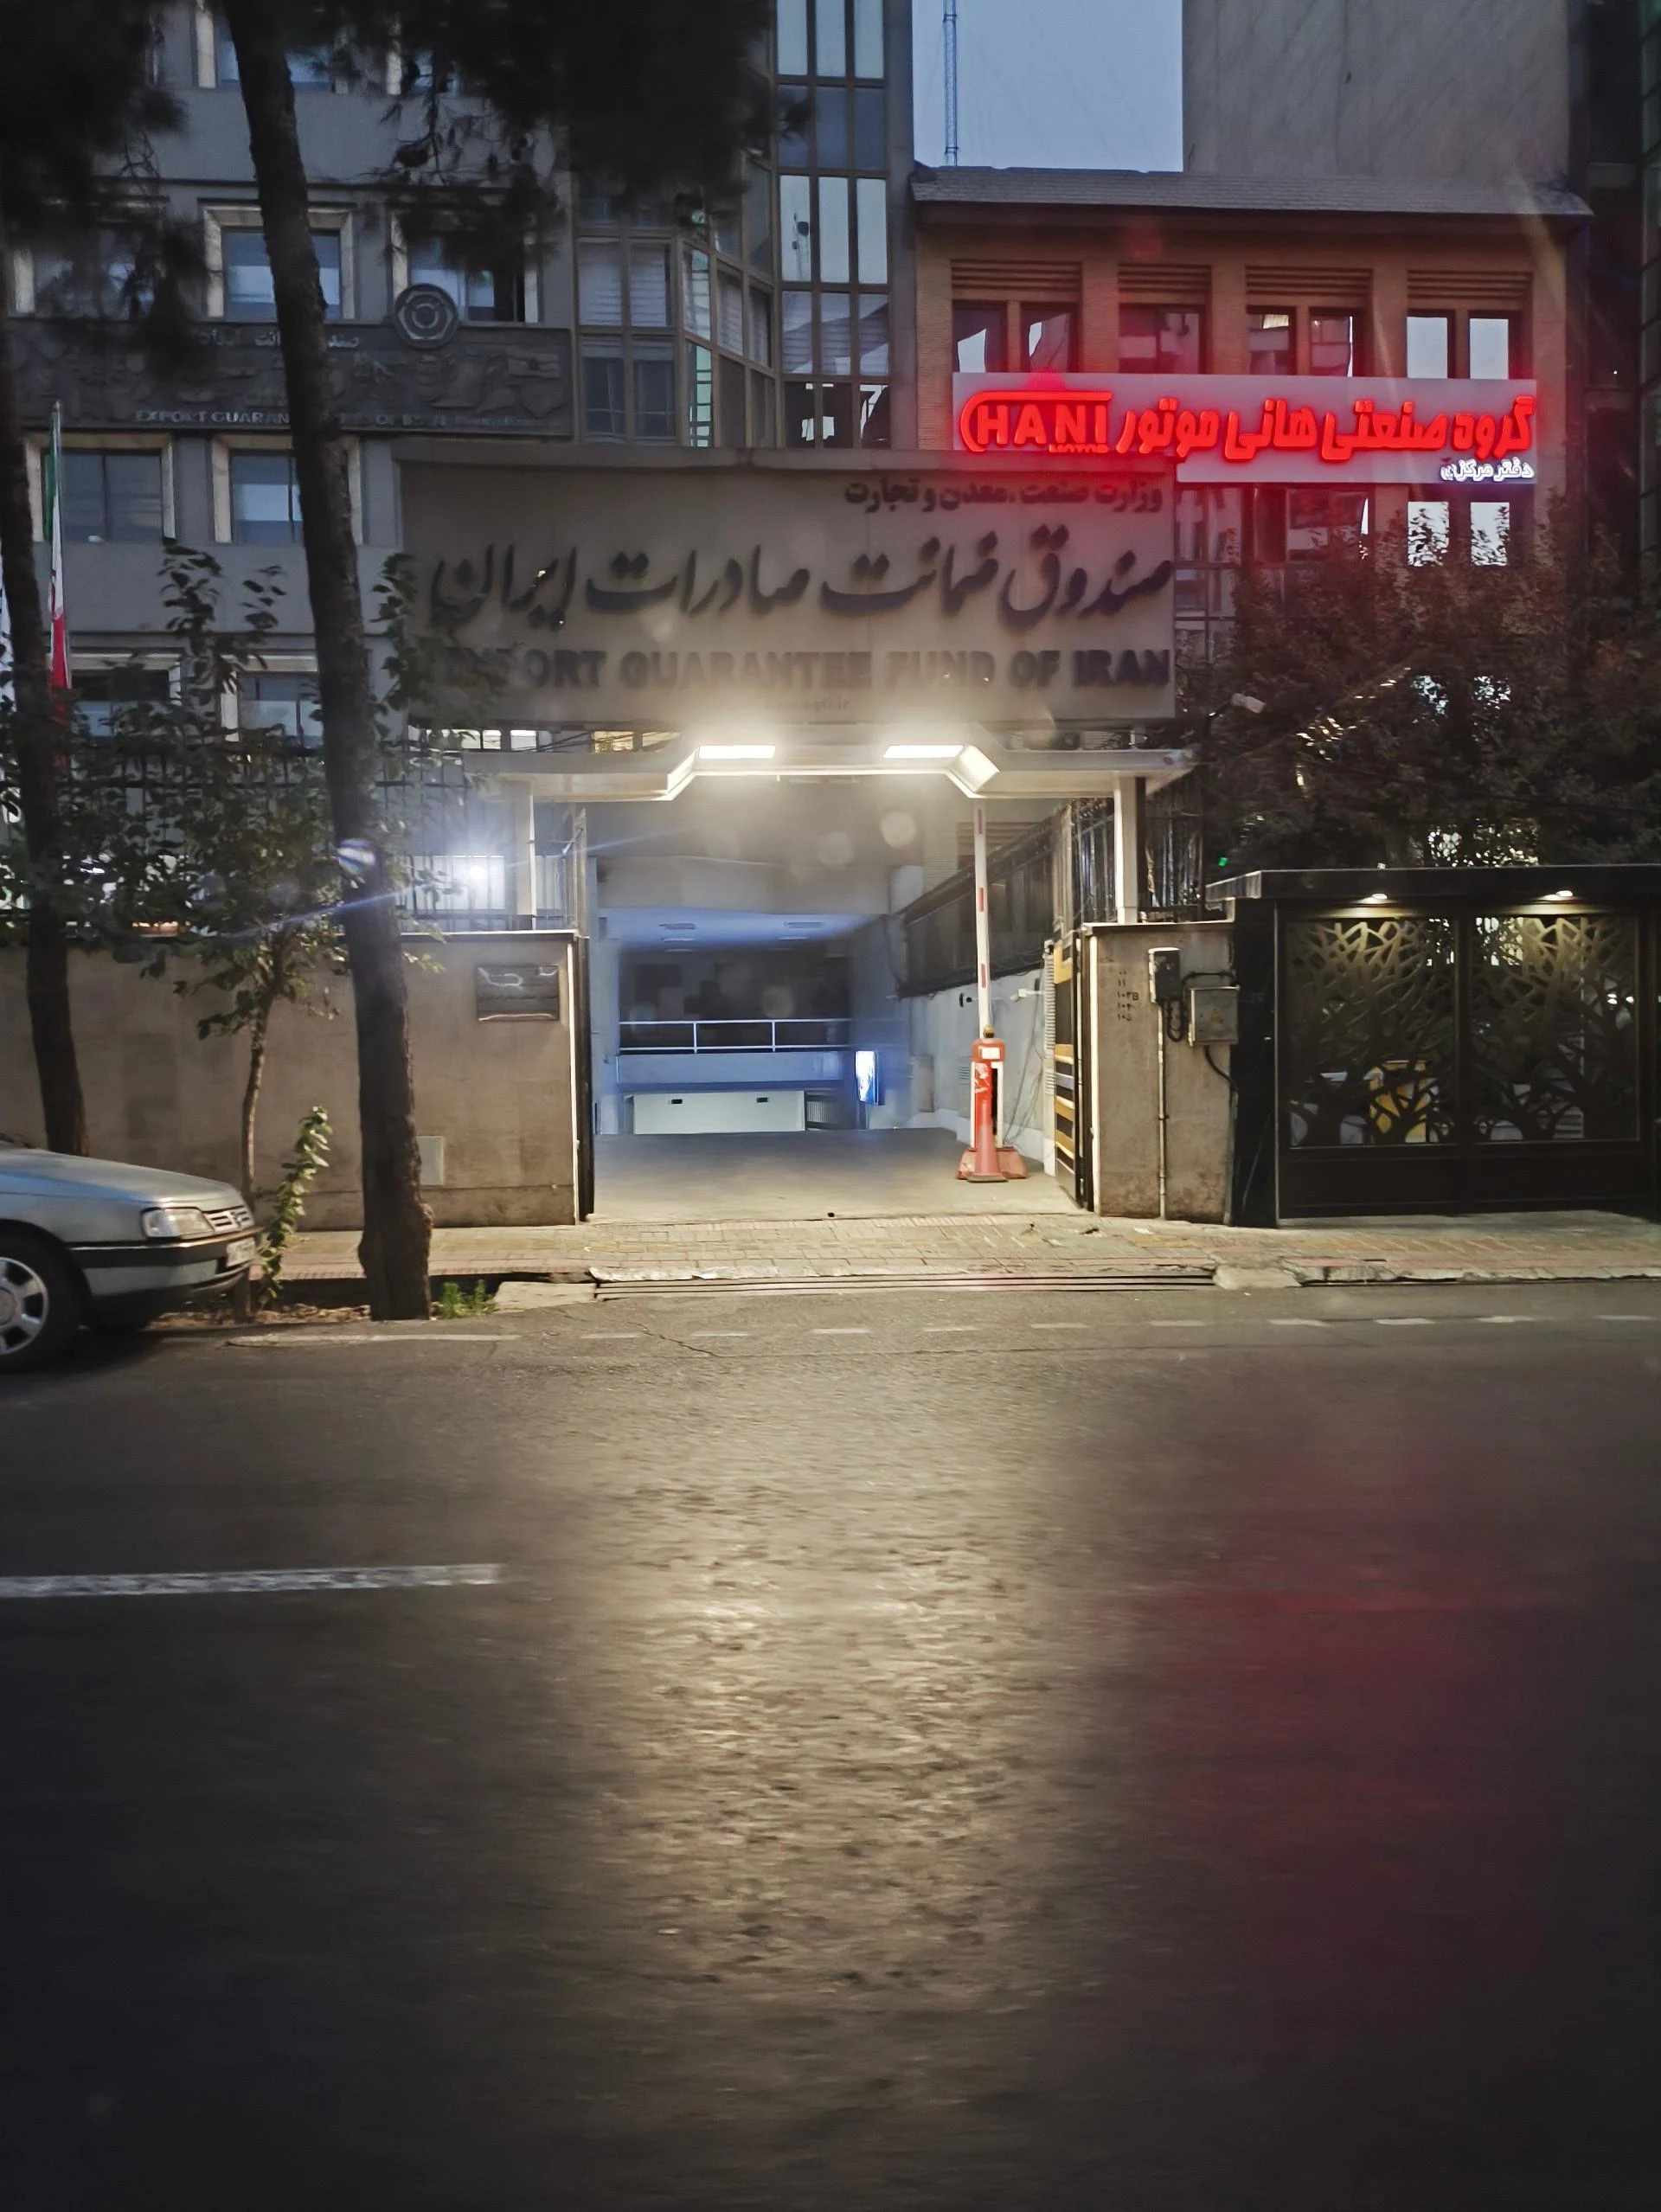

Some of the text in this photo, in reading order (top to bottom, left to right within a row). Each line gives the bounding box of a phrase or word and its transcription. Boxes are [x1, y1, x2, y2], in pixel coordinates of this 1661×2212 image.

[210, 409, 290, 424] GUARAN
[978, 404, 1107, 445] HANI
[1115, 396, 1536, 460] گروه صنعتی هانی موتور
[1492, 456, 1536, 483] دفتر
[844, 477, 920, 512] تجارت
[921, 488, 937, 512] و
[1094, 478, 1163, 512] وزارت
[429, 524, 1171, 635] صندوق ضمانت صادرات ایران
[619, 651, 873, 690] GUARANTEE
[884, 650, 996, 689] FUND
[1010, 650, 1061, 688] OF
[1071, 648, 1170, 688] IRAN
